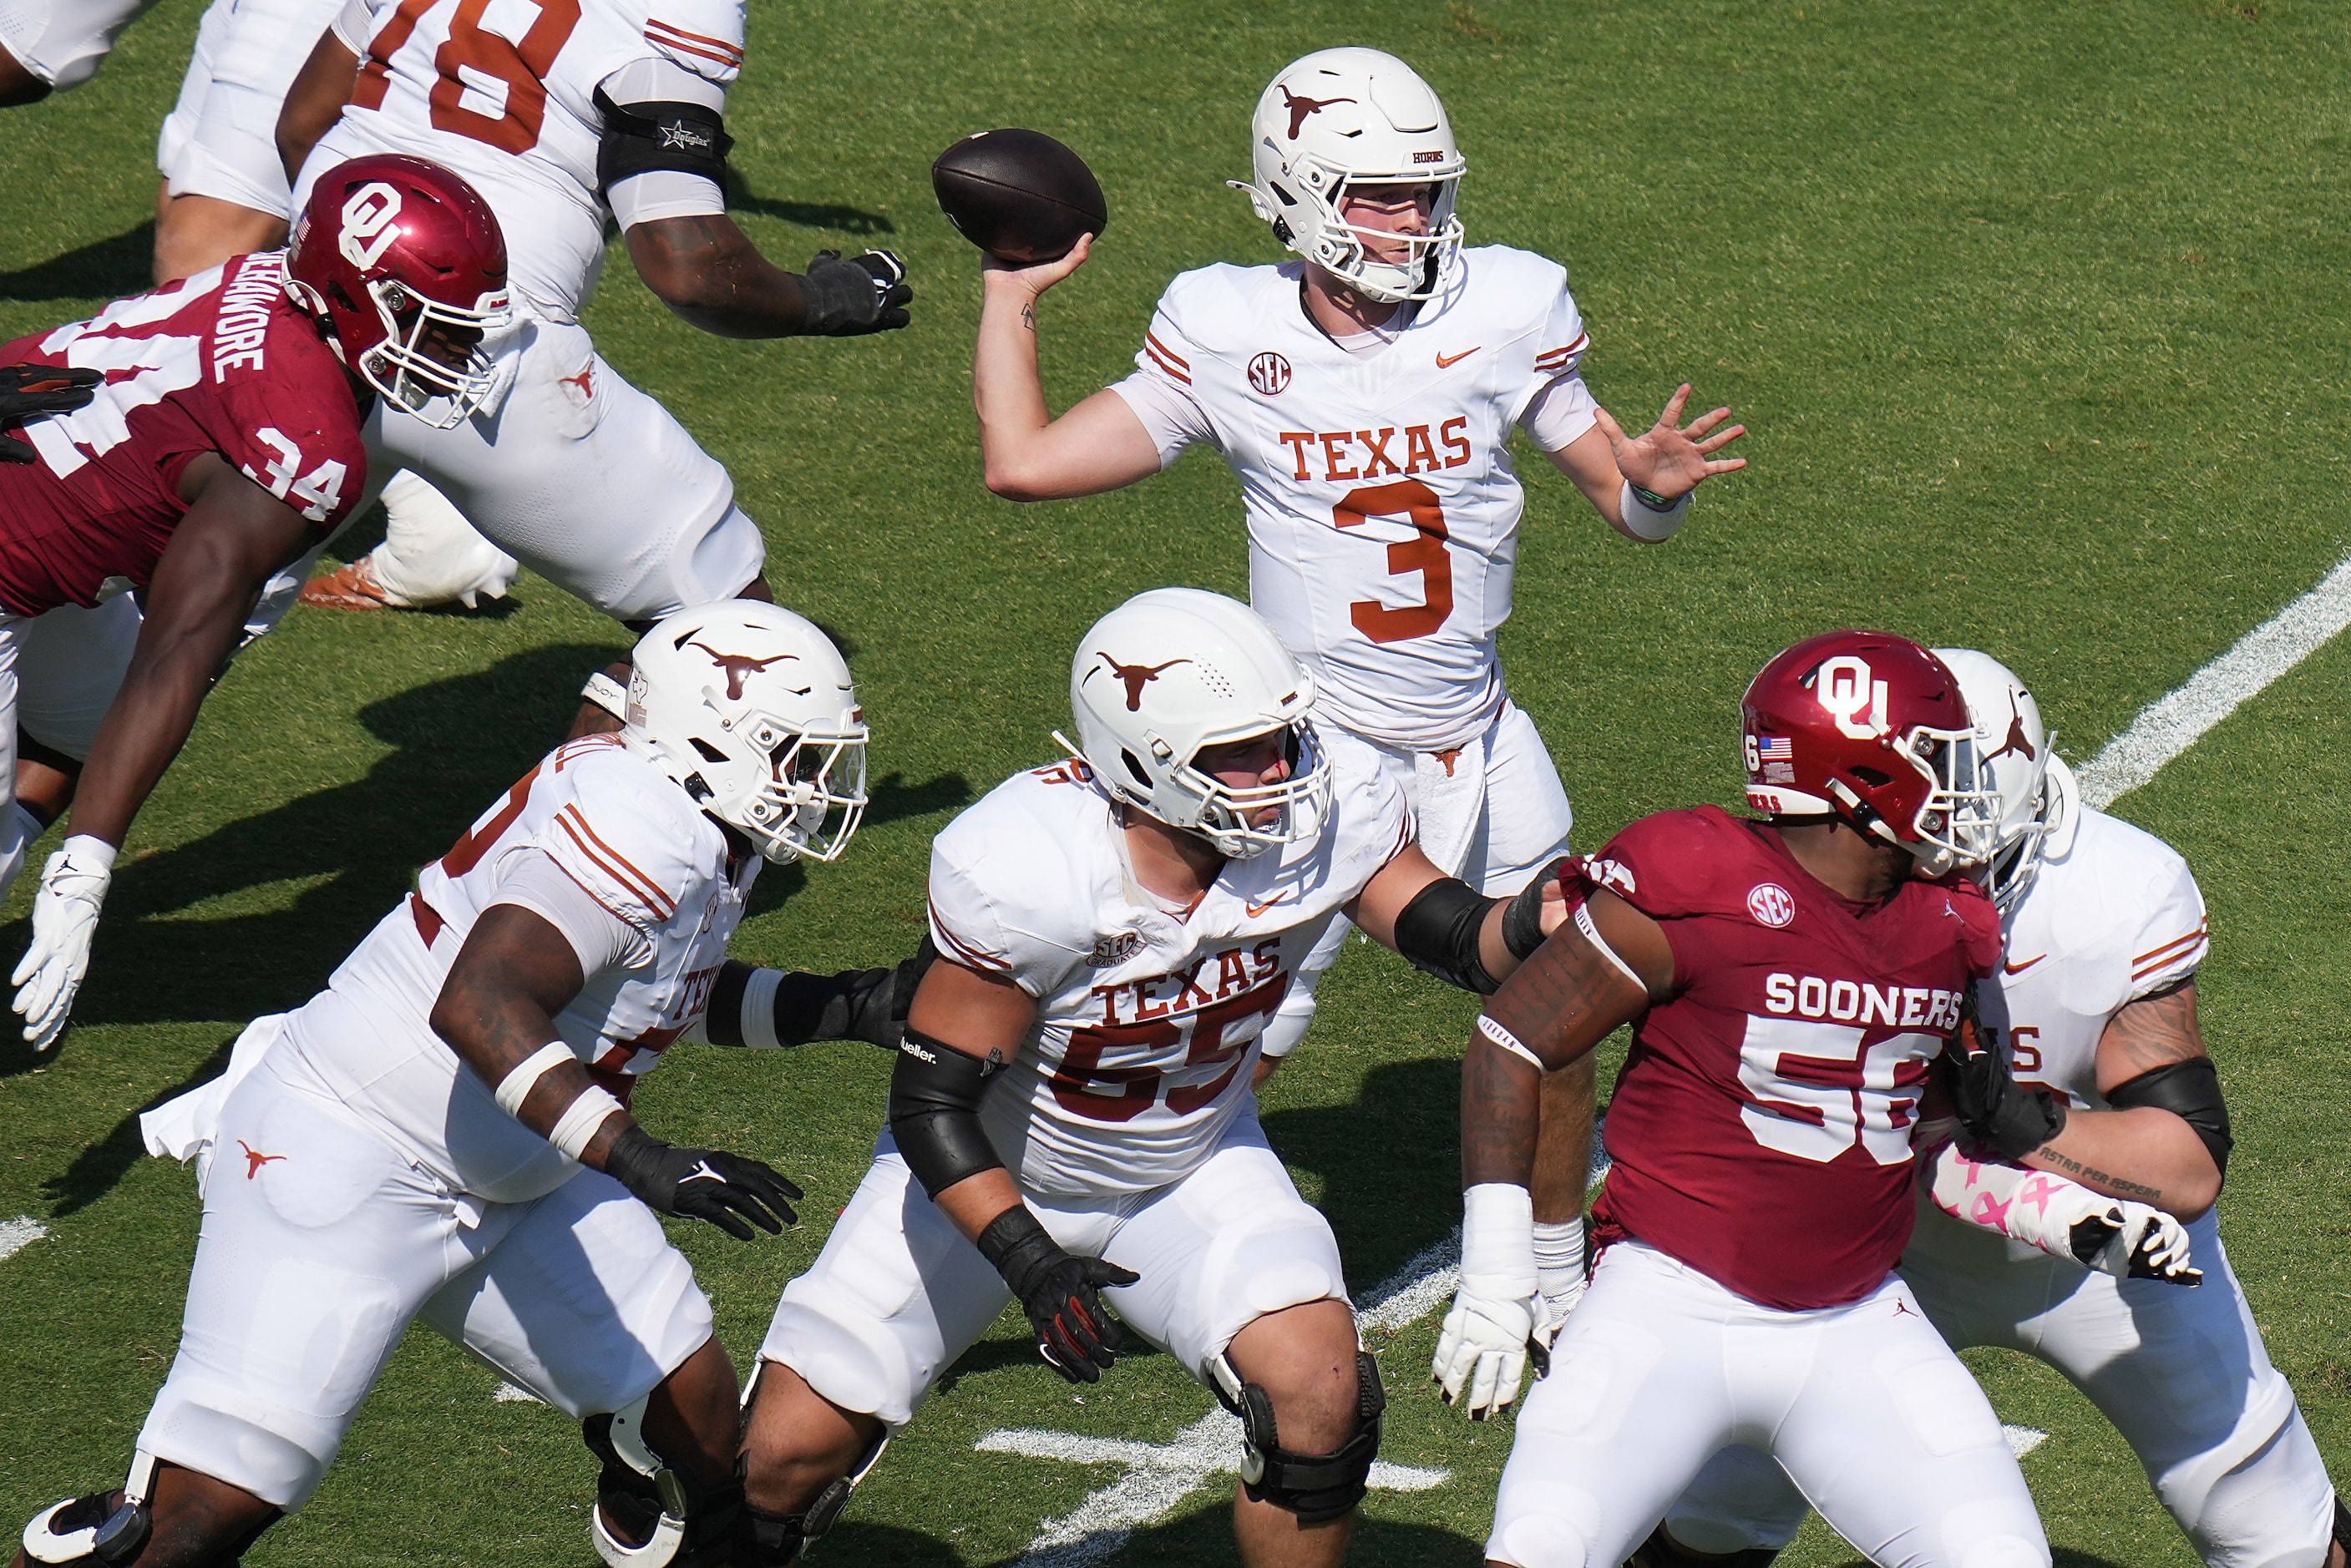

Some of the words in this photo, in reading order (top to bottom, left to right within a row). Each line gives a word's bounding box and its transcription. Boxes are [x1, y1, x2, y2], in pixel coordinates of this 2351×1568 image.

[672, 130, 708, 147] Douglas
[338, 182, 403, 271] OU
[1249, 352, 1292, 396] SEC
[241, 427, 347, 522] 34
[1279, 415, 1472, 482] TEXAS
[1331, 478, 1454, 645] 3
[1817, 656, 1889, 741] OU
[1751, 887, 1791, 925] SEC
[1092, 936, 1281, 1026] TEXAS
[1096, 933, 1135, 957] SEC
[1766, 973, 1963, 1030] SOONERS
[1047, 970, 1289, 1123] 65
[1737, 1013, 1943, 1166] 56
[2039, 1146, 2082, 1174] ASTRA
[2082, 1166, 2110, 1184] PER
